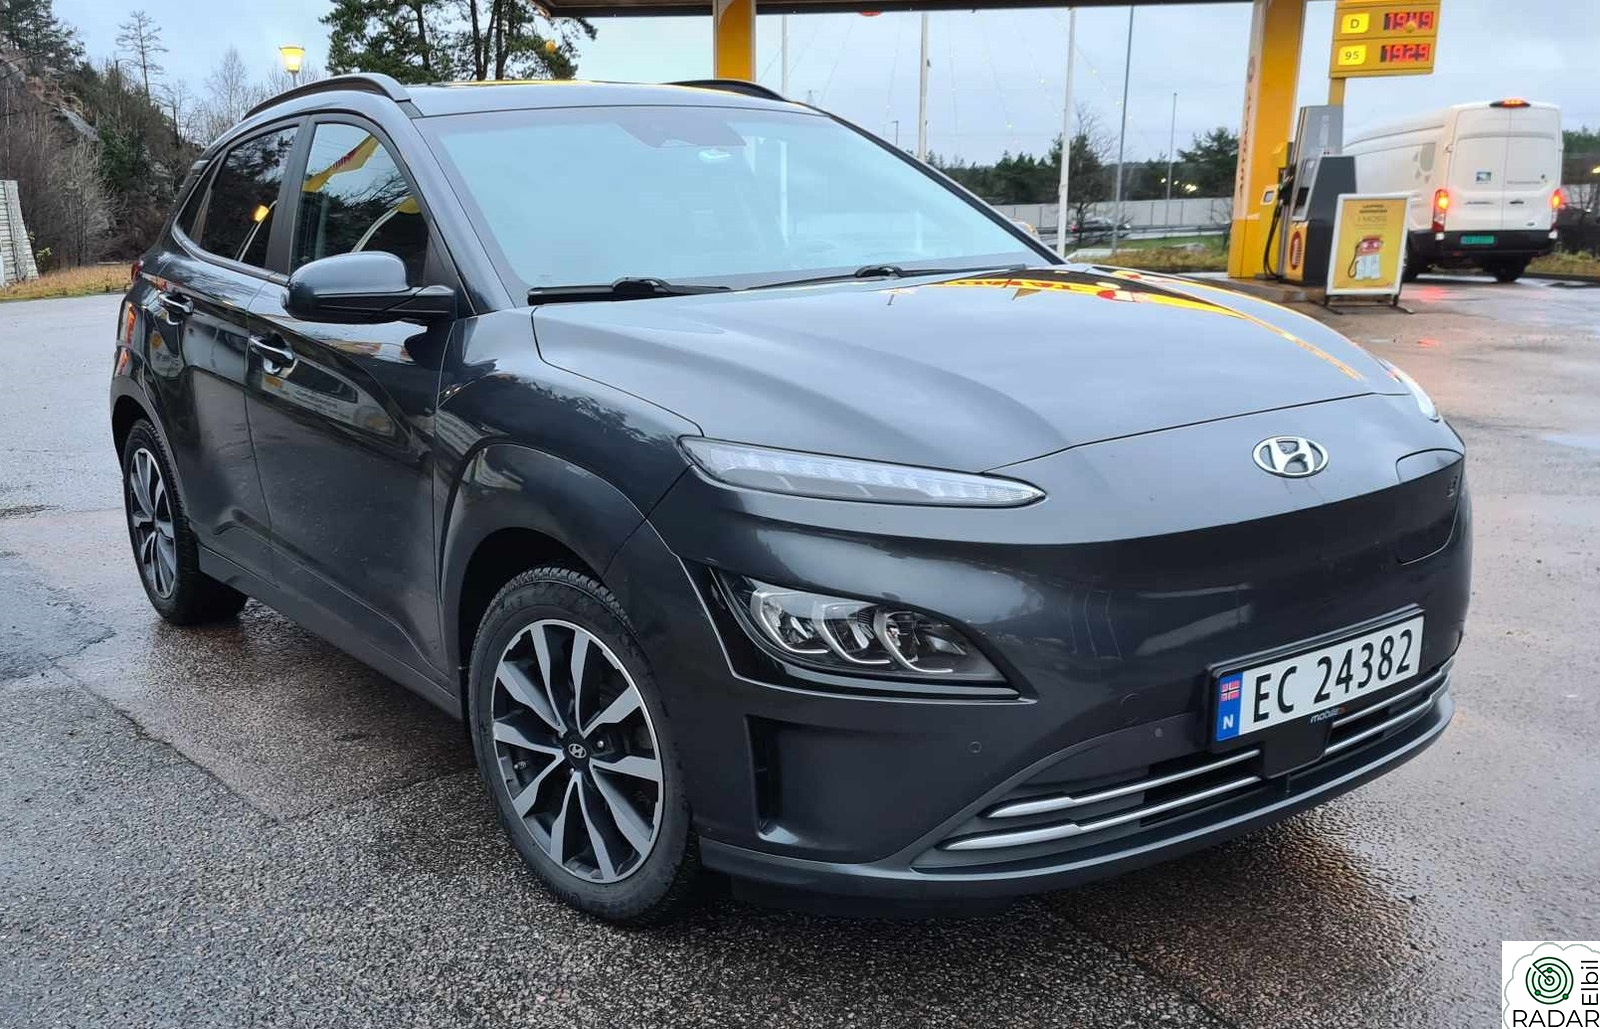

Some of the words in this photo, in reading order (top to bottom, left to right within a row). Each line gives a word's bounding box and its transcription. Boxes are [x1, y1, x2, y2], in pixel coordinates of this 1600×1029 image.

[1350, 19, 1360, 29] D
[1345, 51, 1360, 60] 95
[1385, 44, 1429, 62] 1929
[1253, 665, 1298, 723] EC
[1314, 629, 1412, 704] 24382
[1222, 714, 1234, 730] N
